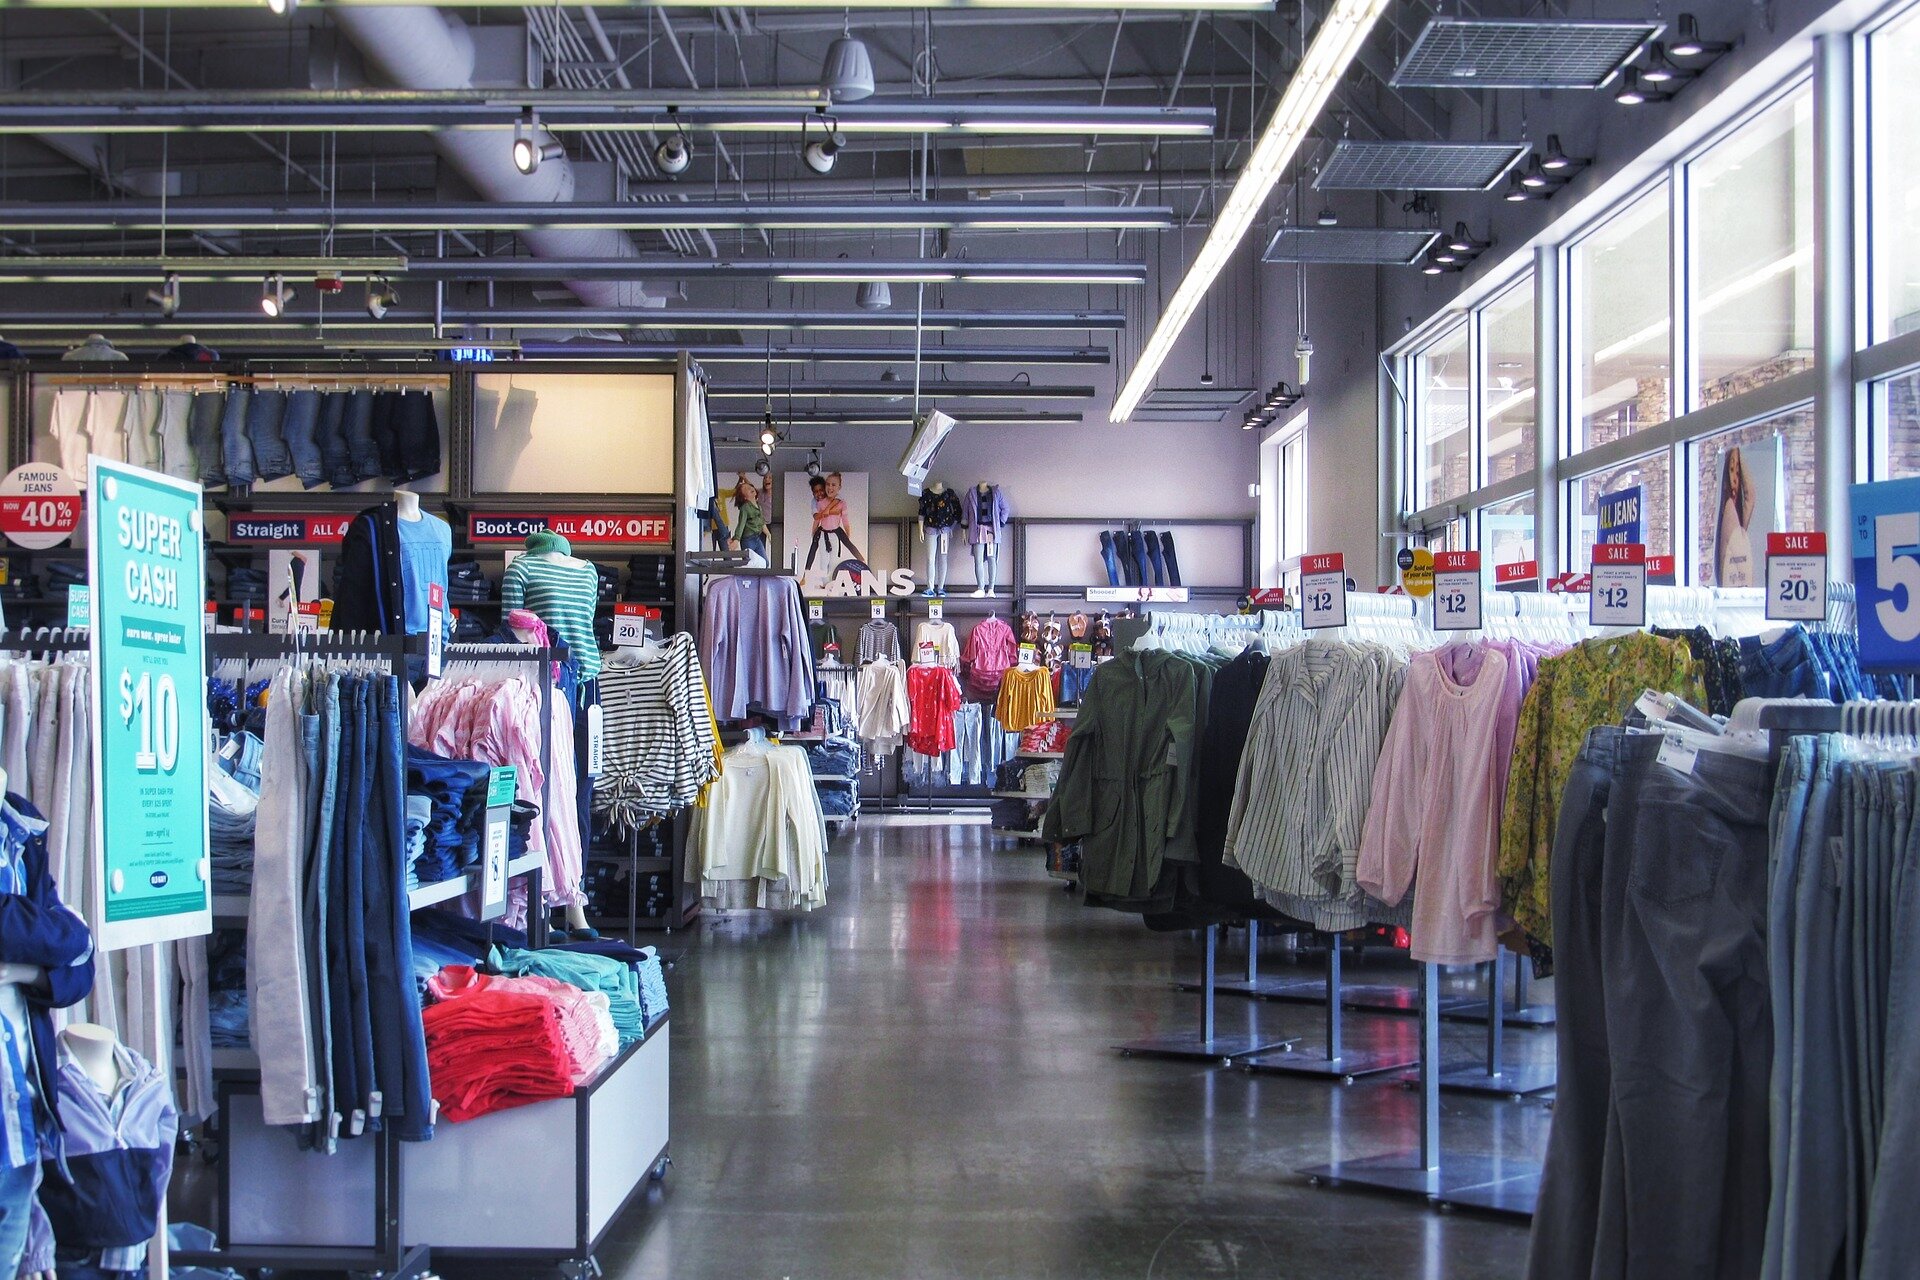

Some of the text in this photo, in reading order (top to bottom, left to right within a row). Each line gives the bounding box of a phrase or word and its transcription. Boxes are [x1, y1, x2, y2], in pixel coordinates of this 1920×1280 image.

[18, 473, 58, 481] FAMOUS
[24, 484, 53, 492] JEANS
[1600, 497, 1637, 529] ALL JEANS
[57, 519, 72, 527] OFF
[1858, 515, 1867, 526] UP
[118, 506, 182, 561] SUPER
[237, 523, 299, 539] Straight
[313, 525, 333, 535] ALL
[476, 520, 666, 536] Boot-Cut ALL 40% OFF
[1859, 529, 1868, 540] TO
[1785, 537, 1809, 548] SALE
[1608, 548, 1629, 559] SALE
[1313, 558, 1330, 569] SALE
[1448, 555, 1466, 566] SALE
[1508, 565, 1525, 576] SALE
[125, 560, 178, 610] CASH
[70, 590, 89, 602] SUPE
[1598, 588, 1628, 608] $12
[1308, 593, 1332, 611] $12
[1440, 594, 1466, 613] $12
[119, 666, 180, 776] $10
